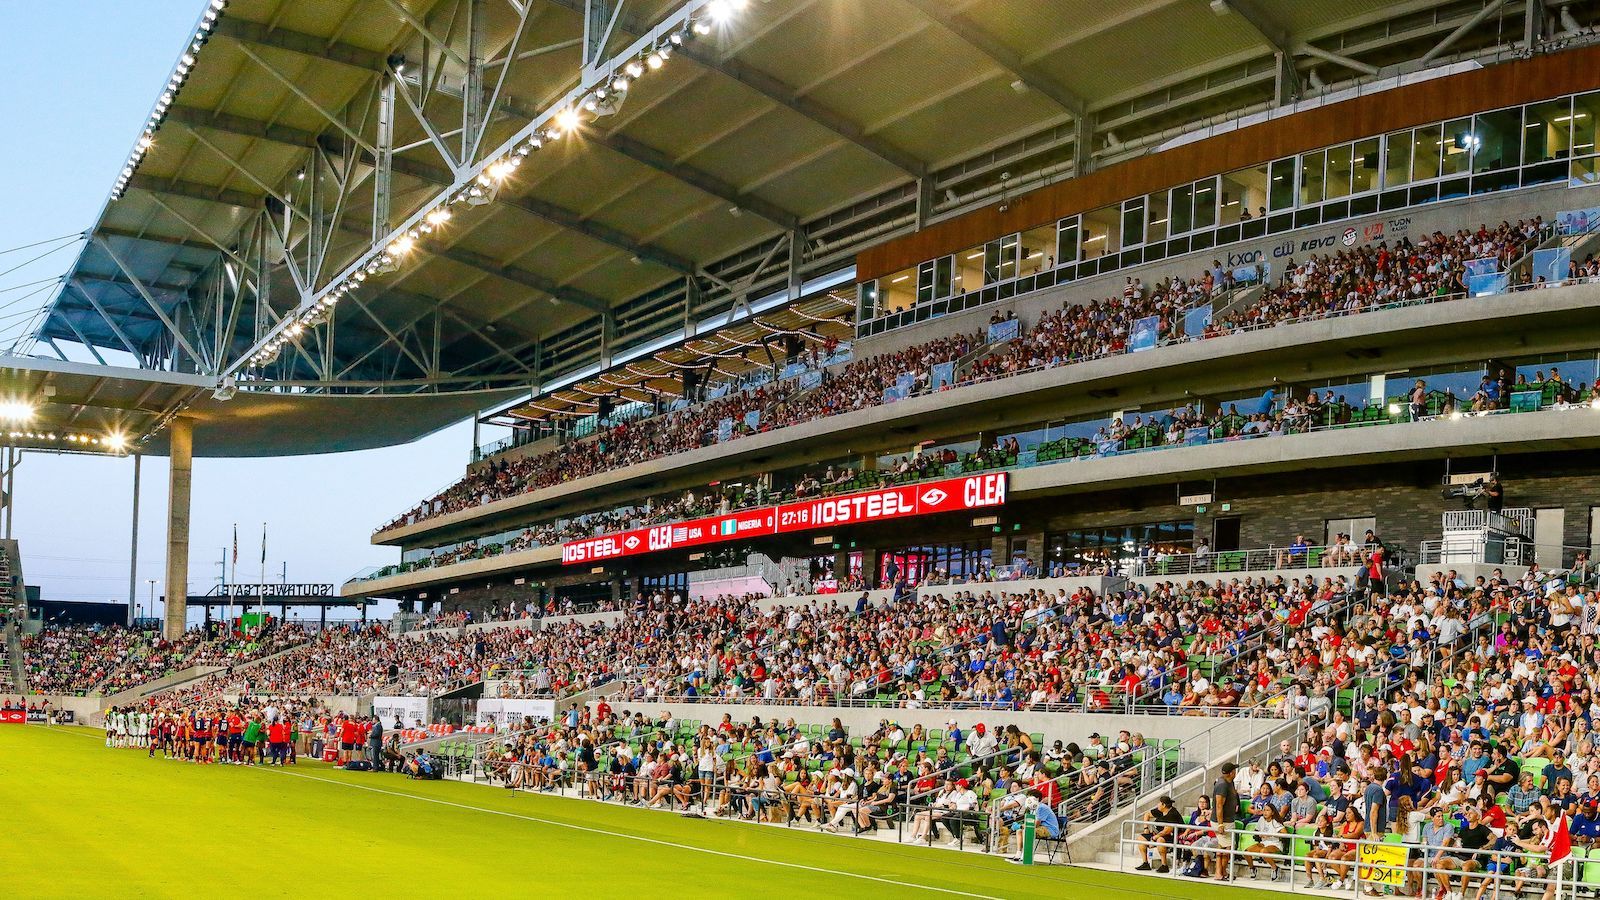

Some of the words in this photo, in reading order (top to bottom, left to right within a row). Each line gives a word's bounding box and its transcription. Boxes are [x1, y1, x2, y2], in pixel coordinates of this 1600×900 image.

[1300, 236, 1336, 252] KBVO
[781, 509, 809, 526] 27:16
[963, 473, 1005, 508] CLEA
[688, 527, 702, 539] USA
[711, 524, 717, 536] 0
[737, 518, 762, 531] NIGERIA
[767, 516, 773, 528] 0
[1501, 718, 1515, 726] USA
